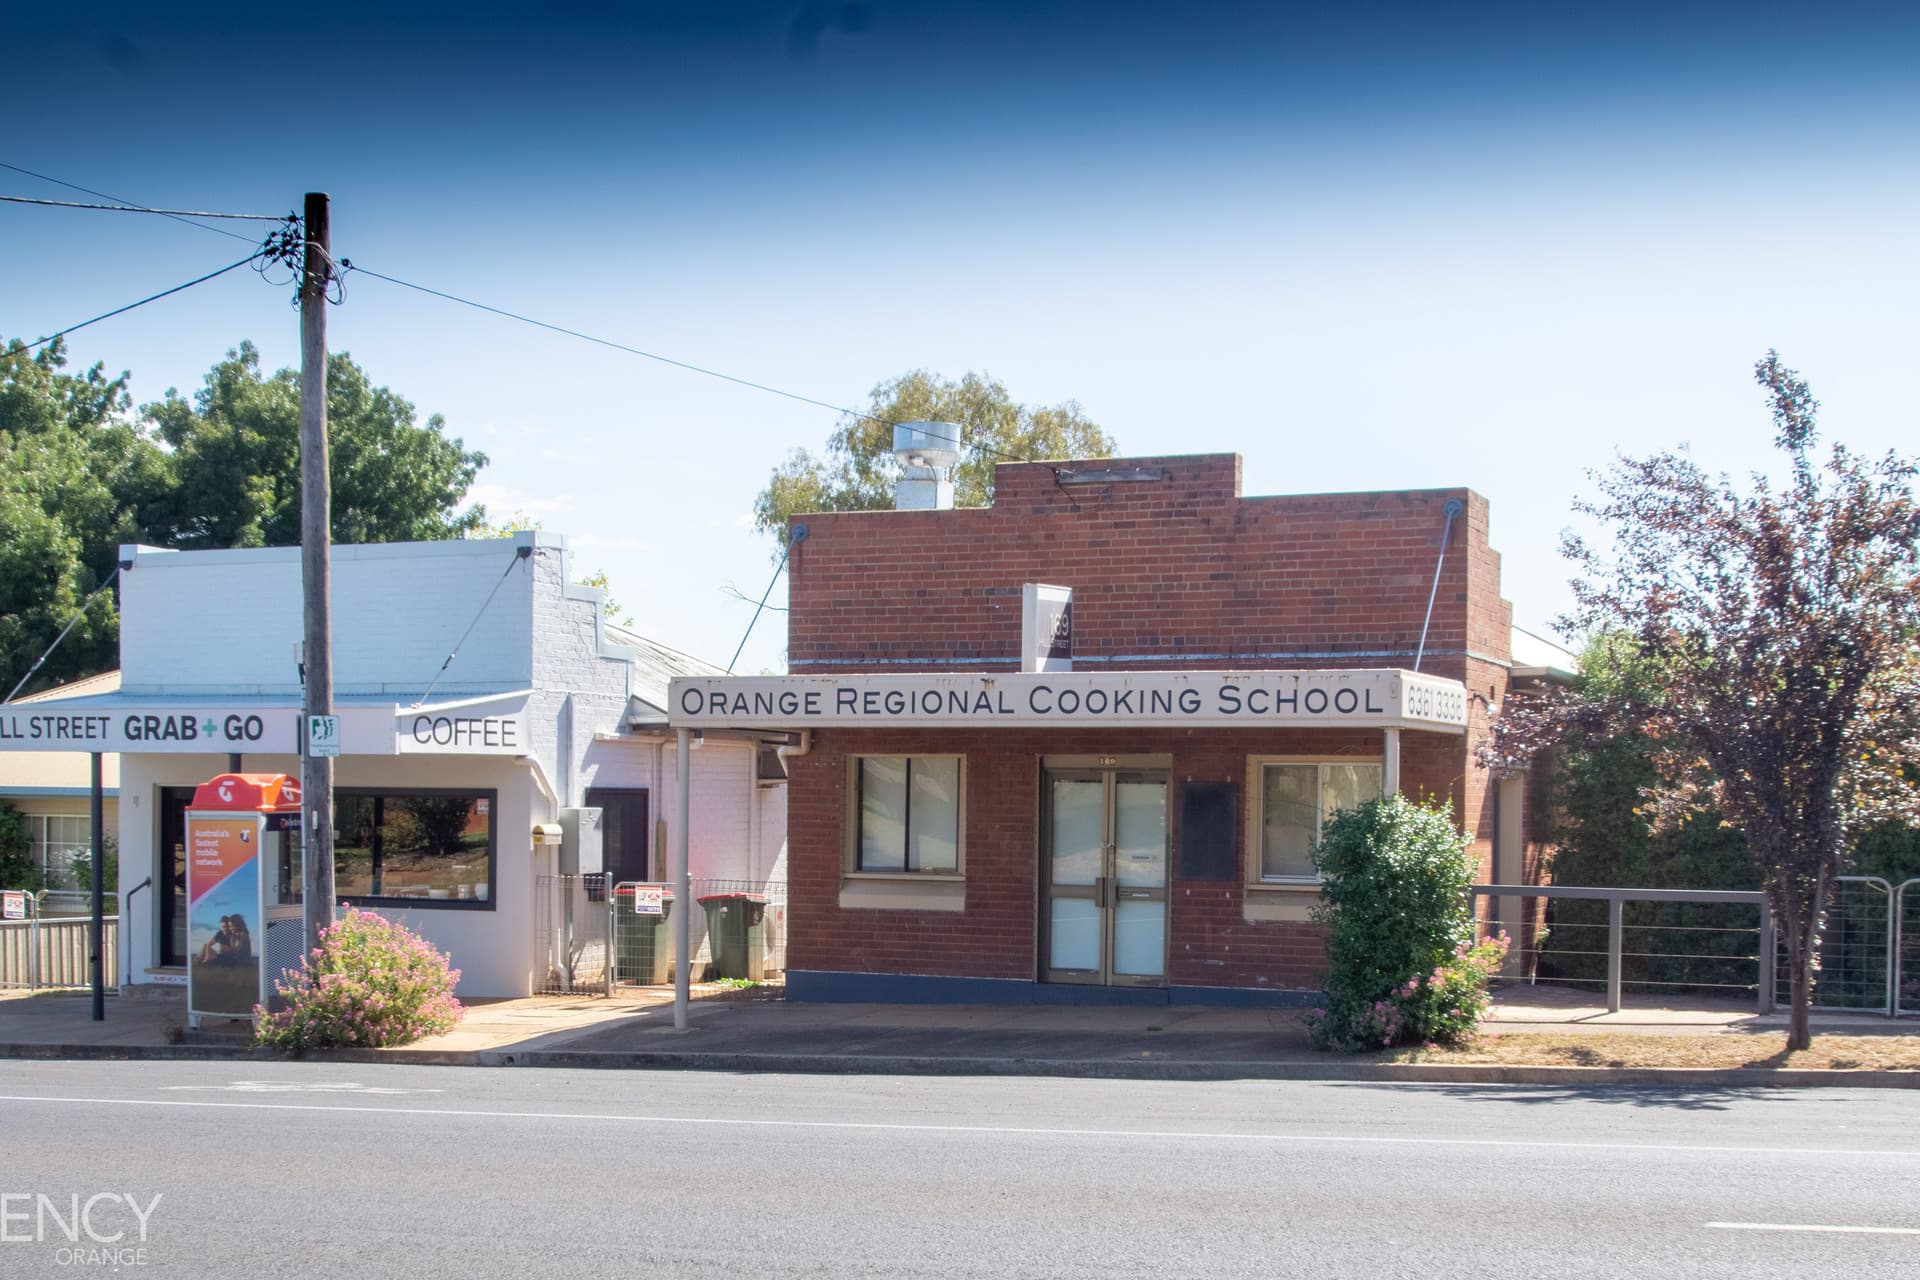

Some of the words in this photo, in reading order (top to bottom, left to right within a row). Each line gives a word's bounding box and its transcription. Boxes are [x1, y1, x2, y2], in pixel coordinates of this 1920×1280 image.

[1050, 613, 1069, 636] 169
[681, 688, 822, 716] ORANGE
[836, 687, 1014, 715] REGIONAL
[1029, 685, 1201, 715] COOKING
[1218, 685, 1383, 714] SCHOOL
[30, 716, 110, 739] STREET
[124, 715, 198, 741] GRAB
[223, 715, 264, 741] GO
[413, 716, 517, 747] COFFEE
